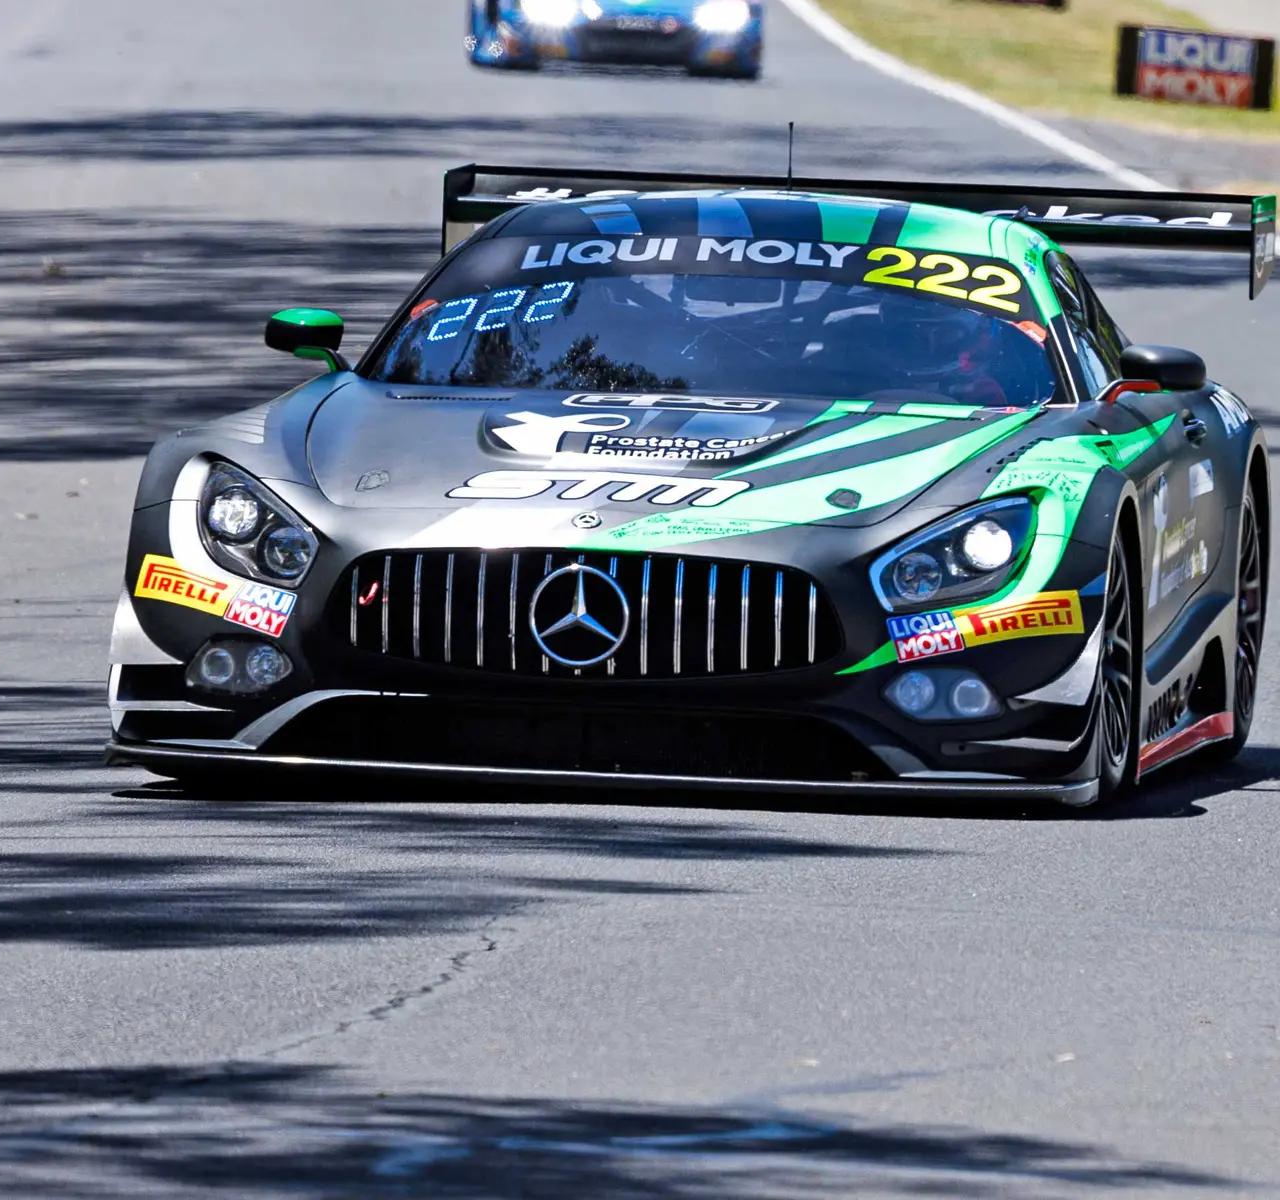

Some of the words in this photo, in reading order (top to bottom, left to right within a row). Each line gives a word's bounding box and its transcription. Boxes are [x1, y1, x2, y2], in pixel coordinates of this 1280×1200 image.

[1146, 31, 1251, 73] LIQUI
[1143, 68, 1249, 106] MOLY
[521, 238, 678, 270] LIQUI
[696, 237, 860, 269] MOLY
[863, 246, 1021, 314] 222
[427, 281, 574, 341] 222
[588, 446, 730, 461] Foundation
[590, 434, 700, 449] Prostate
[445, 470, 754, 507] STM
[142, 562, 228, 604] PIRELLI
[243, 582, 295, 611] LIQUI
[227, 601, 286, 636] MOLY
[890, 611, 955, 638] LIQUI
[966, 598, 1074, 636] PIRELLI
[897, 630, 962, 661] MOLY
